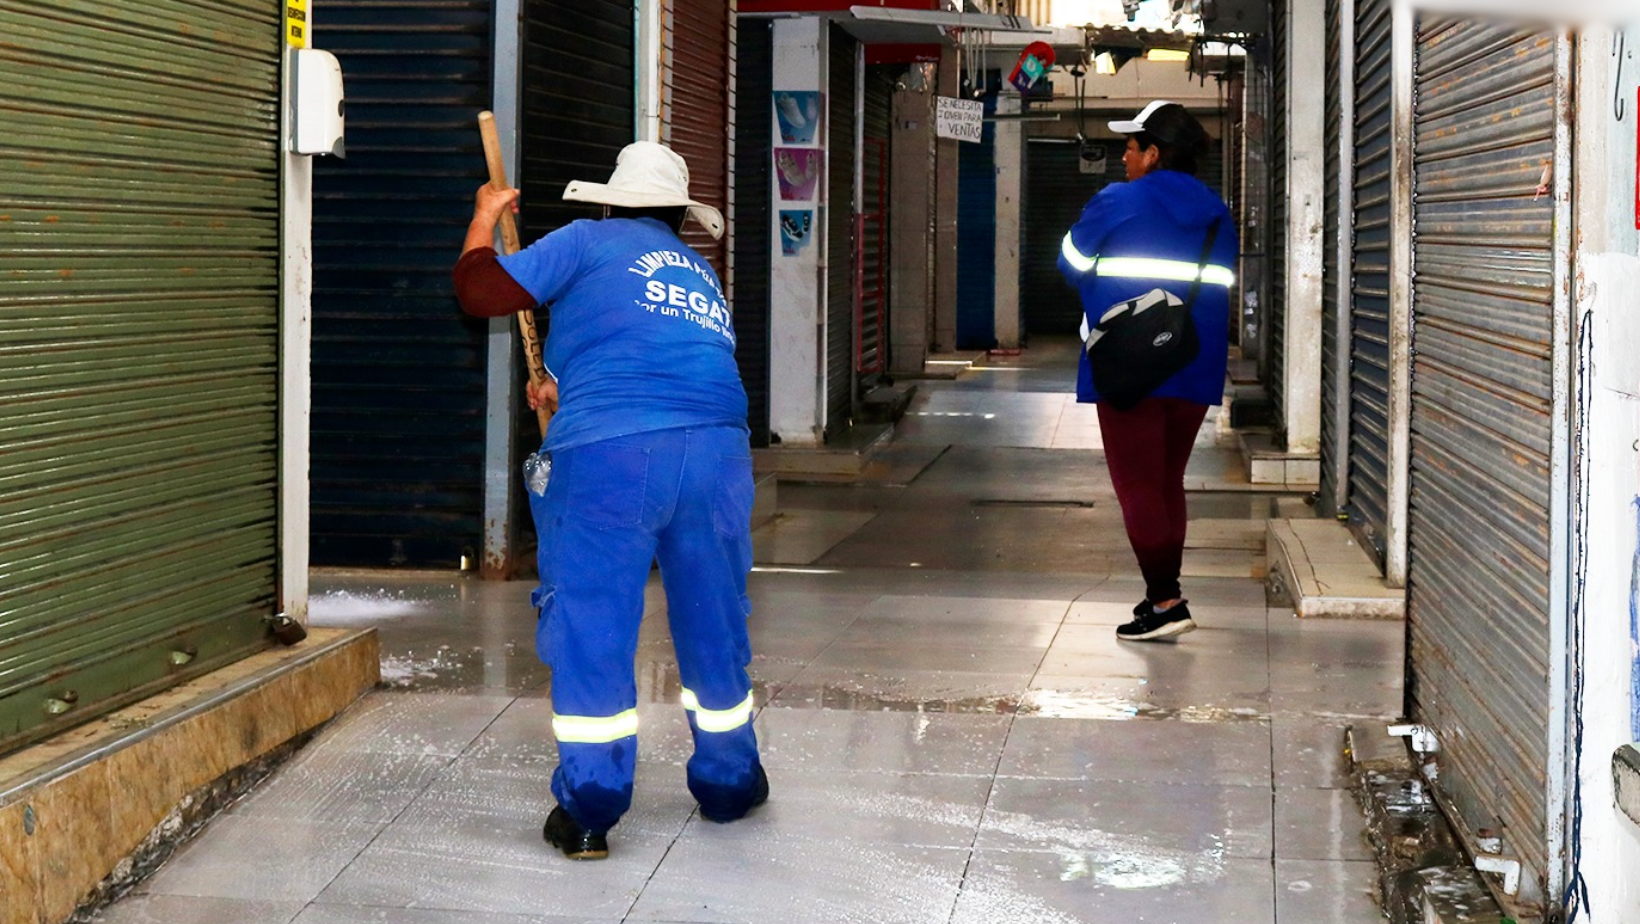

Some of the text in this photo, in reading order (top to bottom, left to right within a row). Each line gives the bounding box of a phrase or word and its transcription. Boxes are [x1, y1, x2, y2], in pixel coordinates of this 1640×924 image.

[938, 98, 982, 111] SE NECESITA
[963, 112, 982, 122] PARA
[948, 122, 981, 139] VENTAS
[628, 250, 693, 277] LIMPIEZA
[644, 280, 731, 328] SEGAT
[661, 306, 679, 317] un
[682, 308, 720, 333] Trujillo
